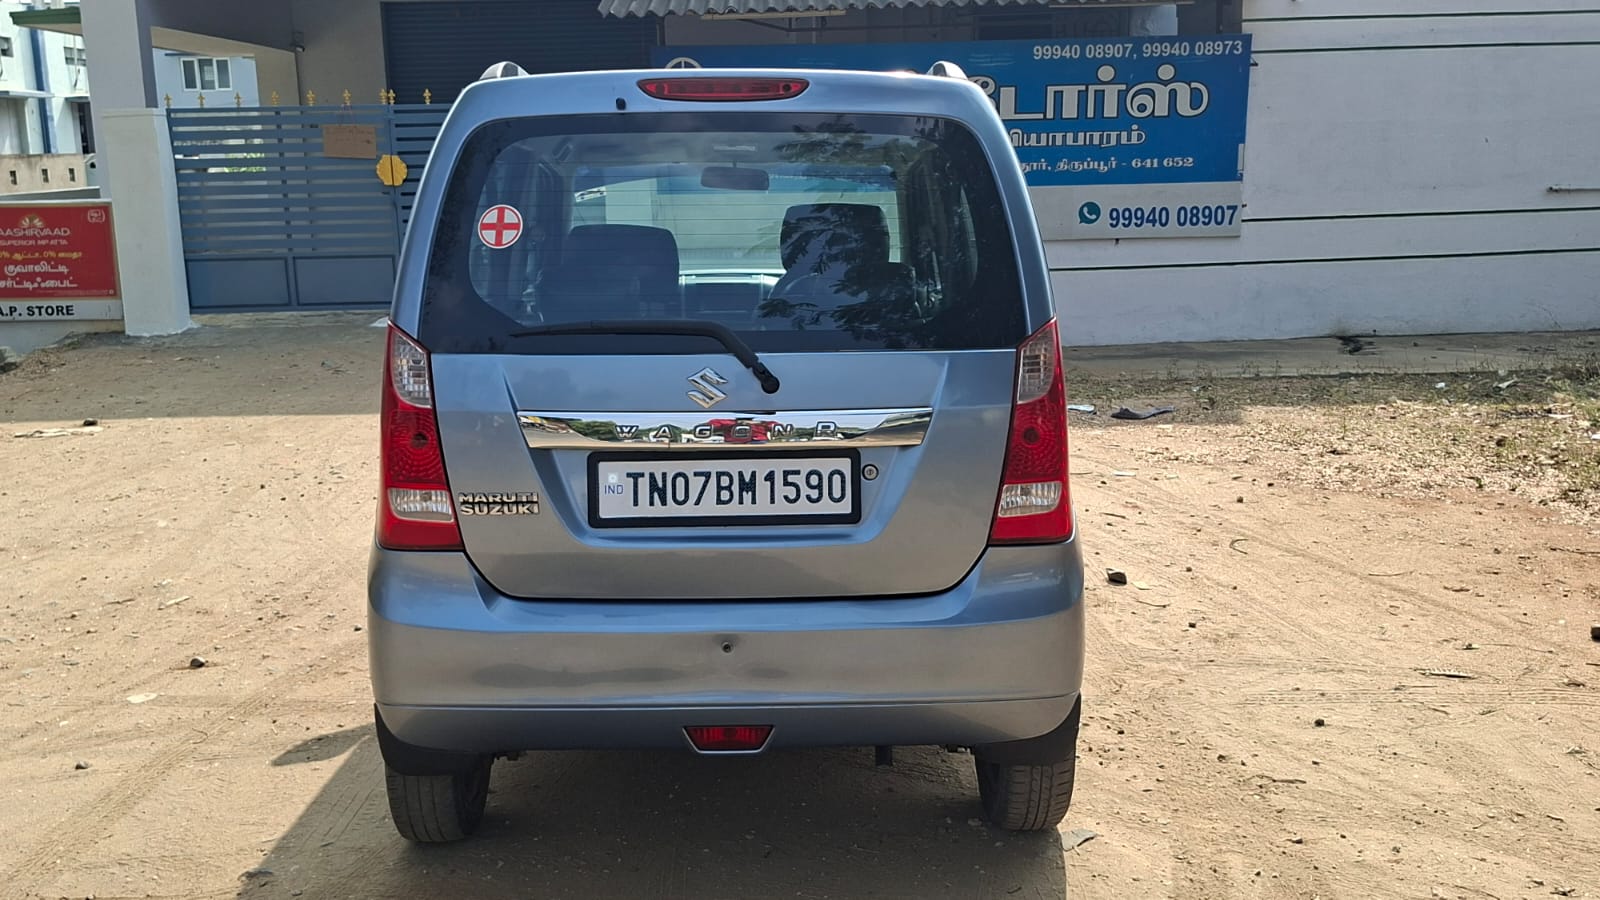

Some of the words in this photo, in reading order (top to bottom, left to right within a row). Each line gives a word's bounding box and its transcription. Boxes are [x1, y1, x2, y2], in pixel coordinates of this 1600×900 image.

[1033, 45, 1080, 60] 99940
[1085, 43, 1137, 60] 08907,
[1142, 42, 1190, 57] 99940
[1194, 40, 1243, 56] 08973
[1055, 156, 1118, 172] திருப்பூர்
[1131, 158, 1159, 169] 641
[1163, 157, 1194, 168] 652
[1109, 206, 1170, 228] 99940
[1176, 204, 1238, 227] 08907
[26, 304, 75, 317] STORE
[604, 484, 624, 496] IND
[626, 468, 847, 507] TN07BM1590
[458, 492, 539, 503] MARUTI
[460, 503, 540, 516] SUZUKI
